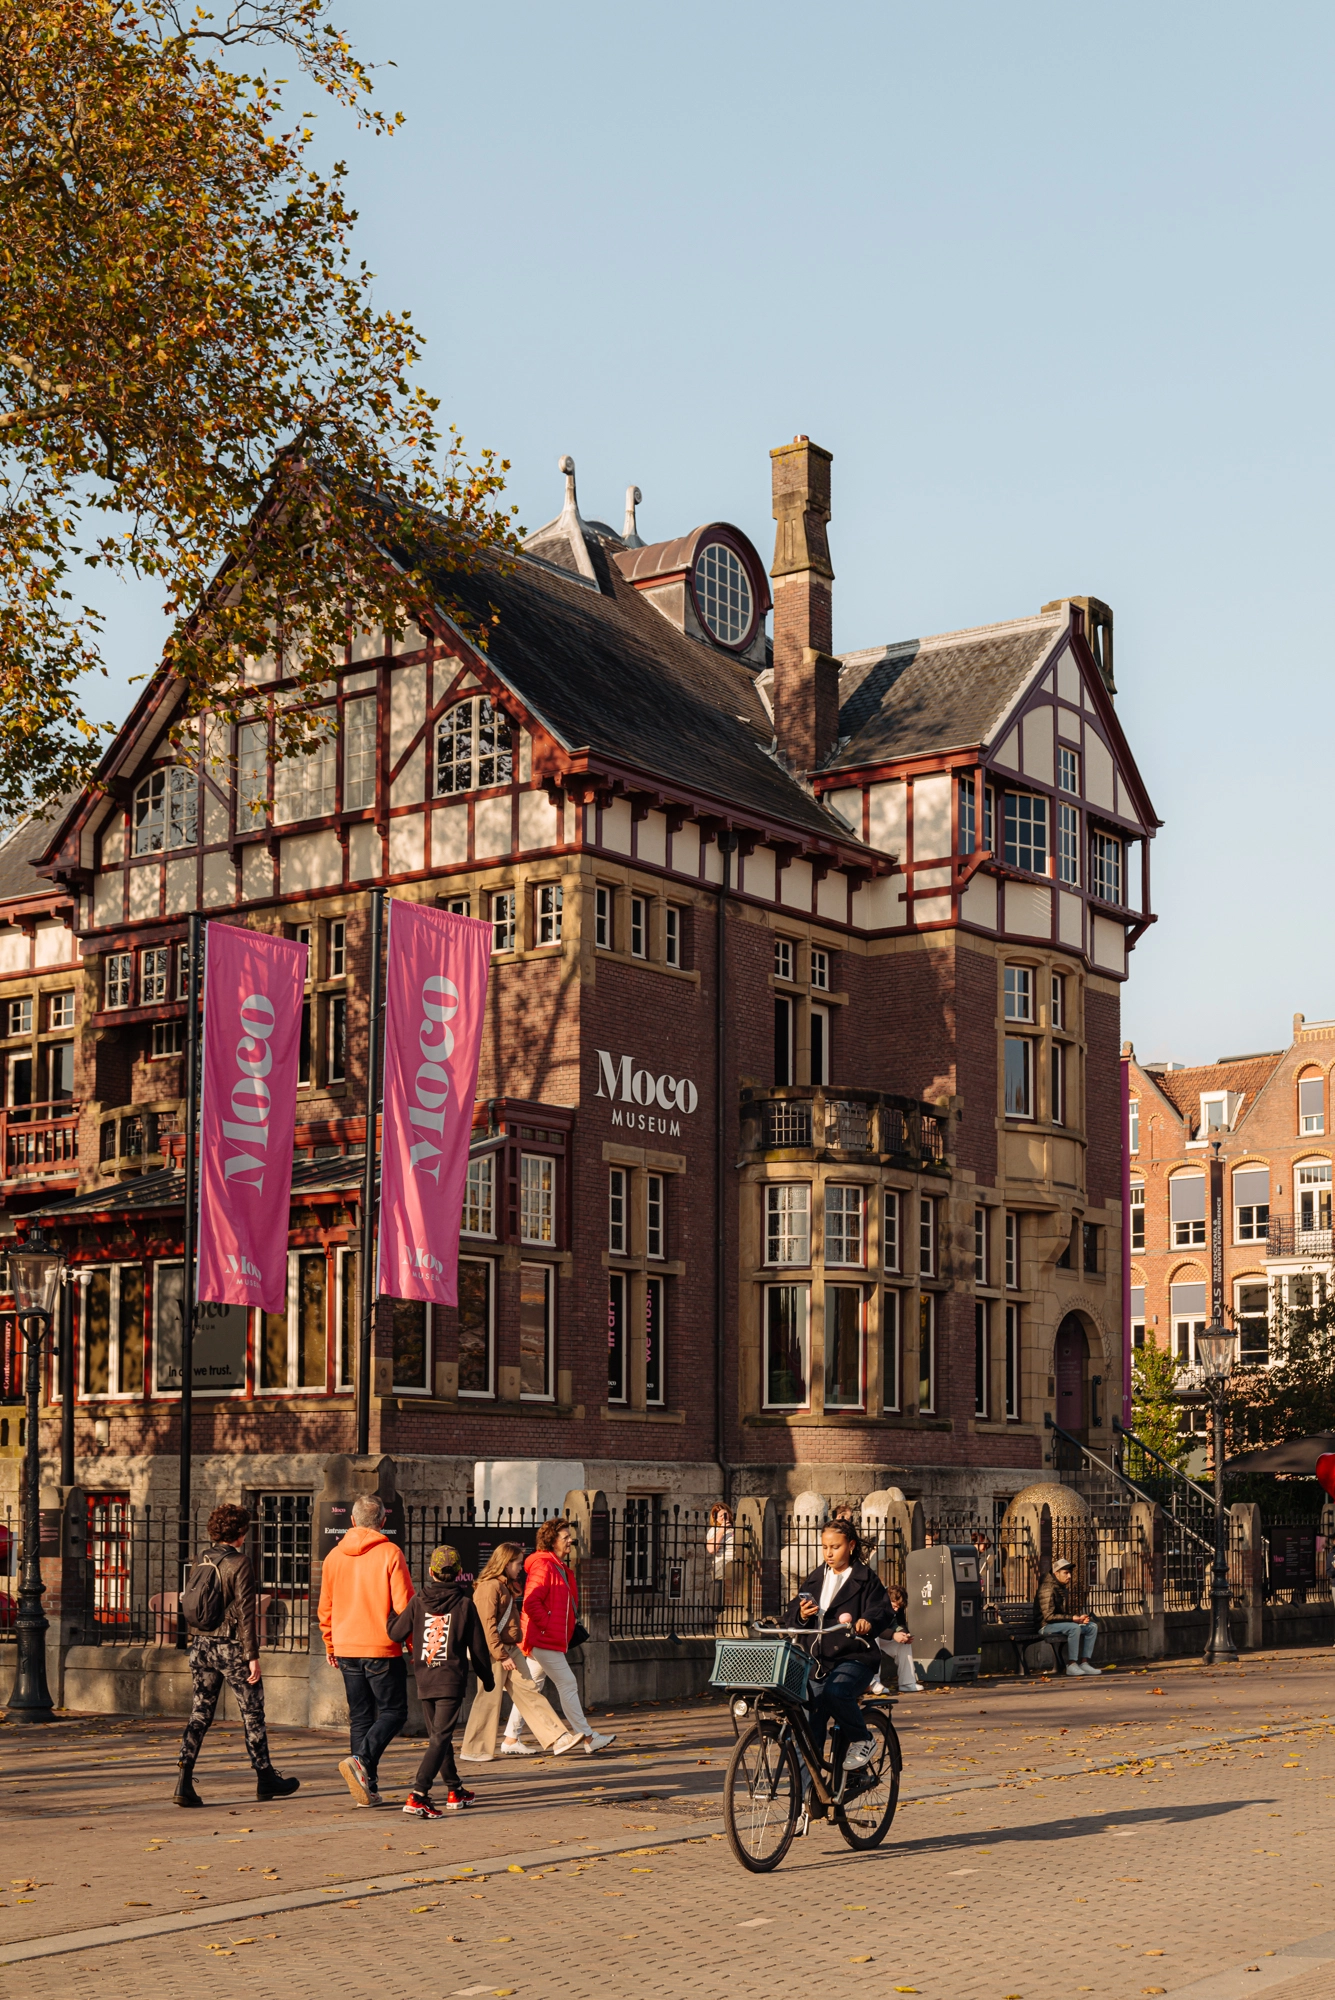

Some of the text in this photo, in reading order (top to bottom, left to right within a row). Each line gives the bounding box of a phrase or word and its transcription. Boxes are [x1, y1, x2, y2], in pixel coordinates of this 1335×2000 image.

[222, 994, 275, 1197] Moco
[408, 975, 459, 1186] Moco
[593, 1049, 698, 1114] Moco
[612, 1108, 680, 1137] MUSEUM
[1213, 1288, 1222, 1317] OLS
[3, 1320, 12, 1390] Contemporary
[168, 1365, 177, 1377] In
[193, 1367, 207, 1376] we
[209, 1364, 232, 1376] trust.
